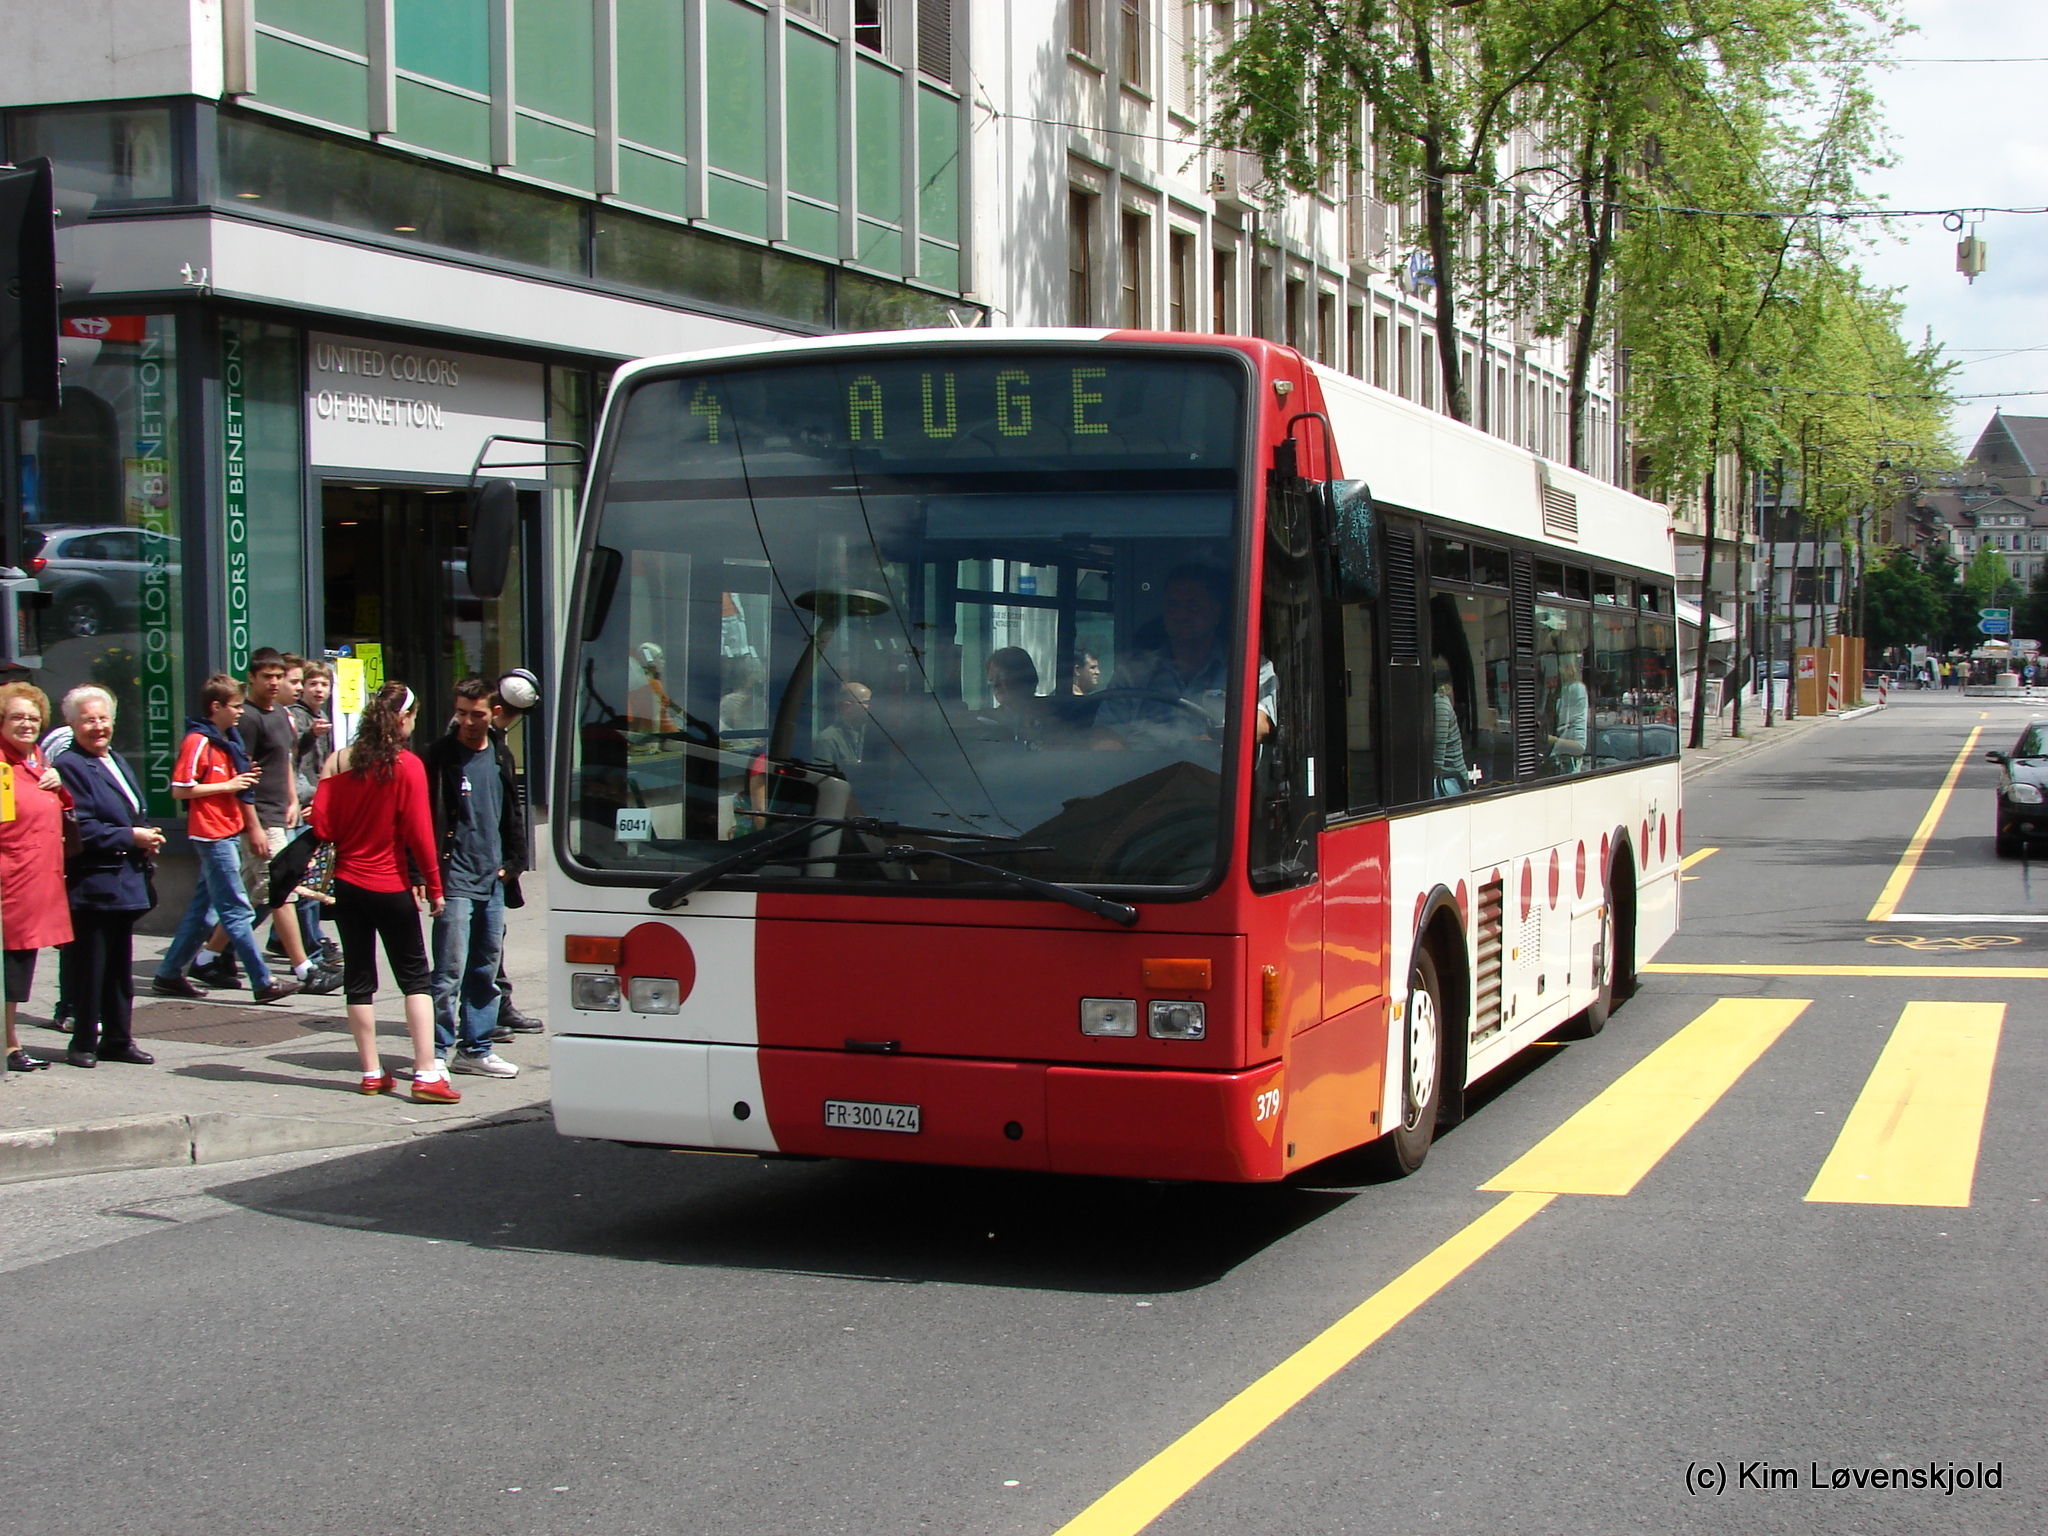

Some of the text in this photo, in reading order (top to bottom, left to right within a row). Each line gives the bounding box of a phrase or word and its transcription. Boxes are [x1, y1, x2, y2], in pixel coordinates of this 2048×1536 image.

[317, 343, 459, 386] UNITED COLORS
[317, 389, 343, 417] OF
[690, 366, 1109, 445] 4 AUGE
[143, 506, 164, 545] OF
[230, 504, 245, 543] OF
[145, 553, 168, 674] COLORS
[231, 552, 248, 671] COLORS
[148, 684, 171, 793] UNITED
[619, 819, 646, 832] 6041
[1256, 1087, 1280, 1122] 379
